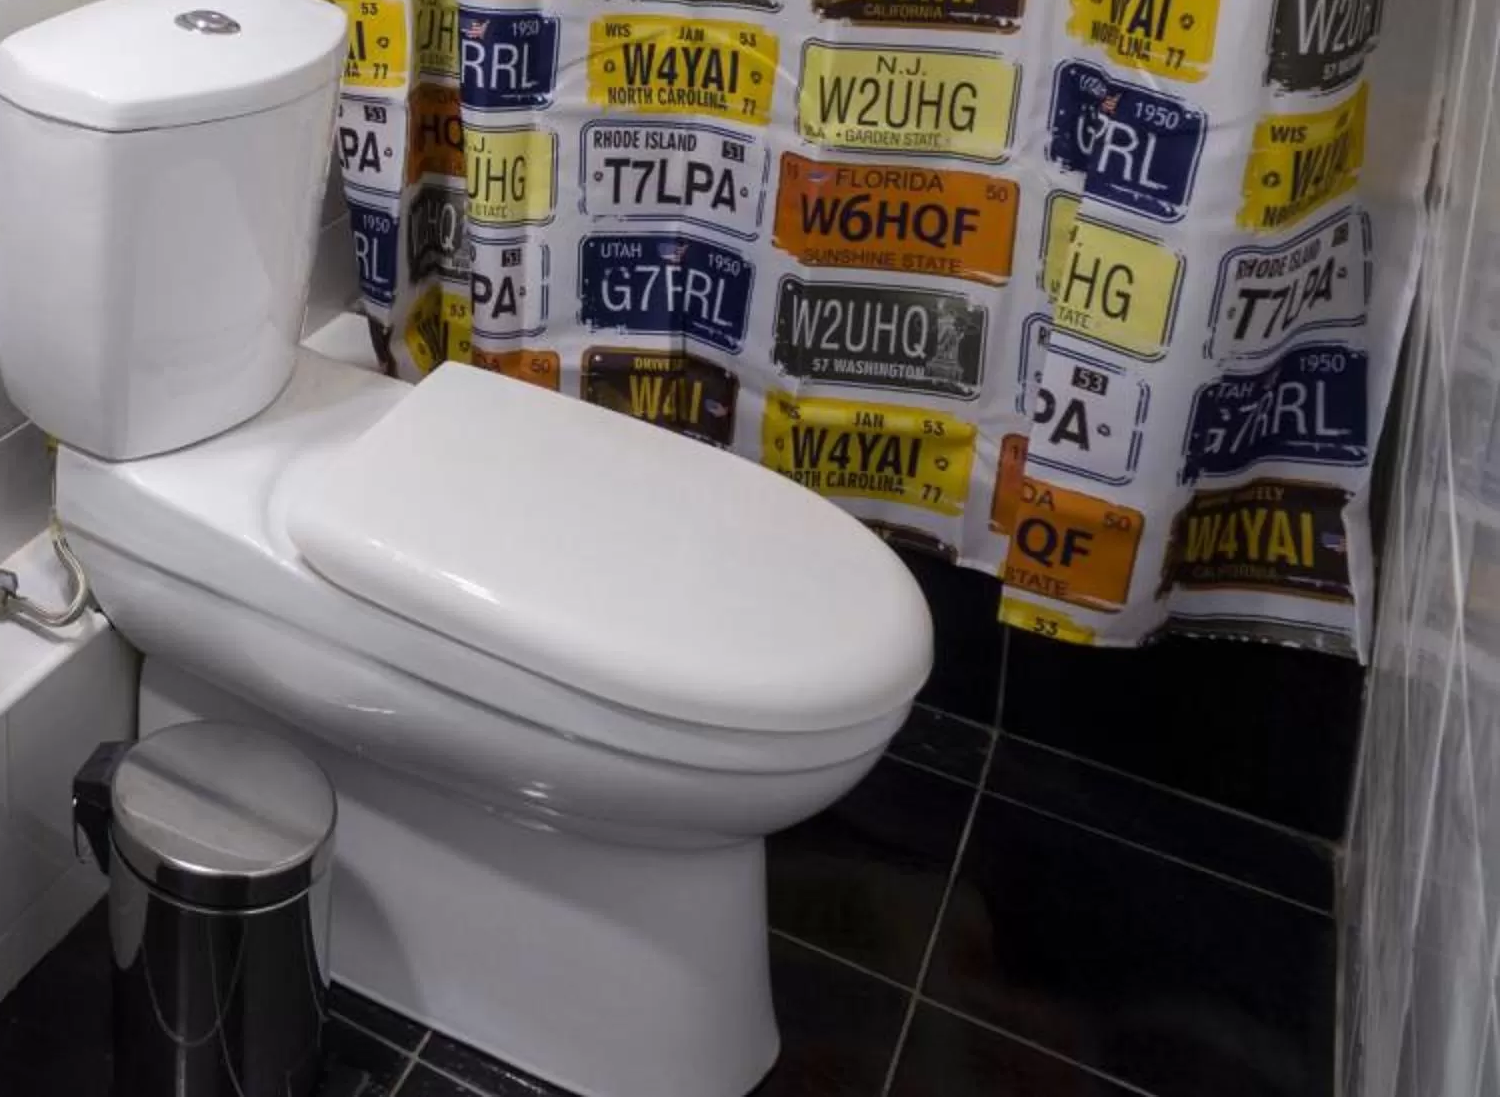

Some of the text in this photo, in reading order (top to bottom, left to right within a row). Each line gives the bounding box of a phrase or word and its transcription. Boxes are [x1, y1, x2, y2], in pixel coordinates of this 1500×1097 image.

[360, 2, 378, 16] 53
[605, 22, 757, 48] WIS JAN 53
[373, 62, 388, 80] 77
[621, 42, 740, 94] W4YAI
[875, 54, 927, 78] N.J.
[1166, 46, 1185, 70] 77
[607, 84, 756, 116] NORTH CAROLINA 77
[819, 76, 978, 133] W2UHG
[1135, 101, 1179, 130] 1950
[592, 131, 697, 153] RHODE ISLAND
[845, 132, 942, 150] GARDEN STATE
[1270, 124, 1308, 144] WIS
[604, 158, 738, 215] T7LPA
[835, 169, 1009, 203] FLORIDA 50
[362, 214, 390, 235] 1950
[801, 193, 981, 249] W6HQF
[600, 243, 741, 277] UTAH 1950
[802, 247, 963, 274] SUNSHINE STATE
[791, 294, 928, 359] W2UHQ
[531, 358, 550, 374] 50
[811, 358, 927, 379] 57 WASHINGTON
[1300, 355, 1347, 374] 1950
[854, 410, 945, 436] JAN 53
[789, 424, 923, 479] W4YAI
[827, 470, 943, 504] CAROLINA 77
[1184, 507, 1314, 570] W4YAI
[1033, 617, 1060, 639] 53
